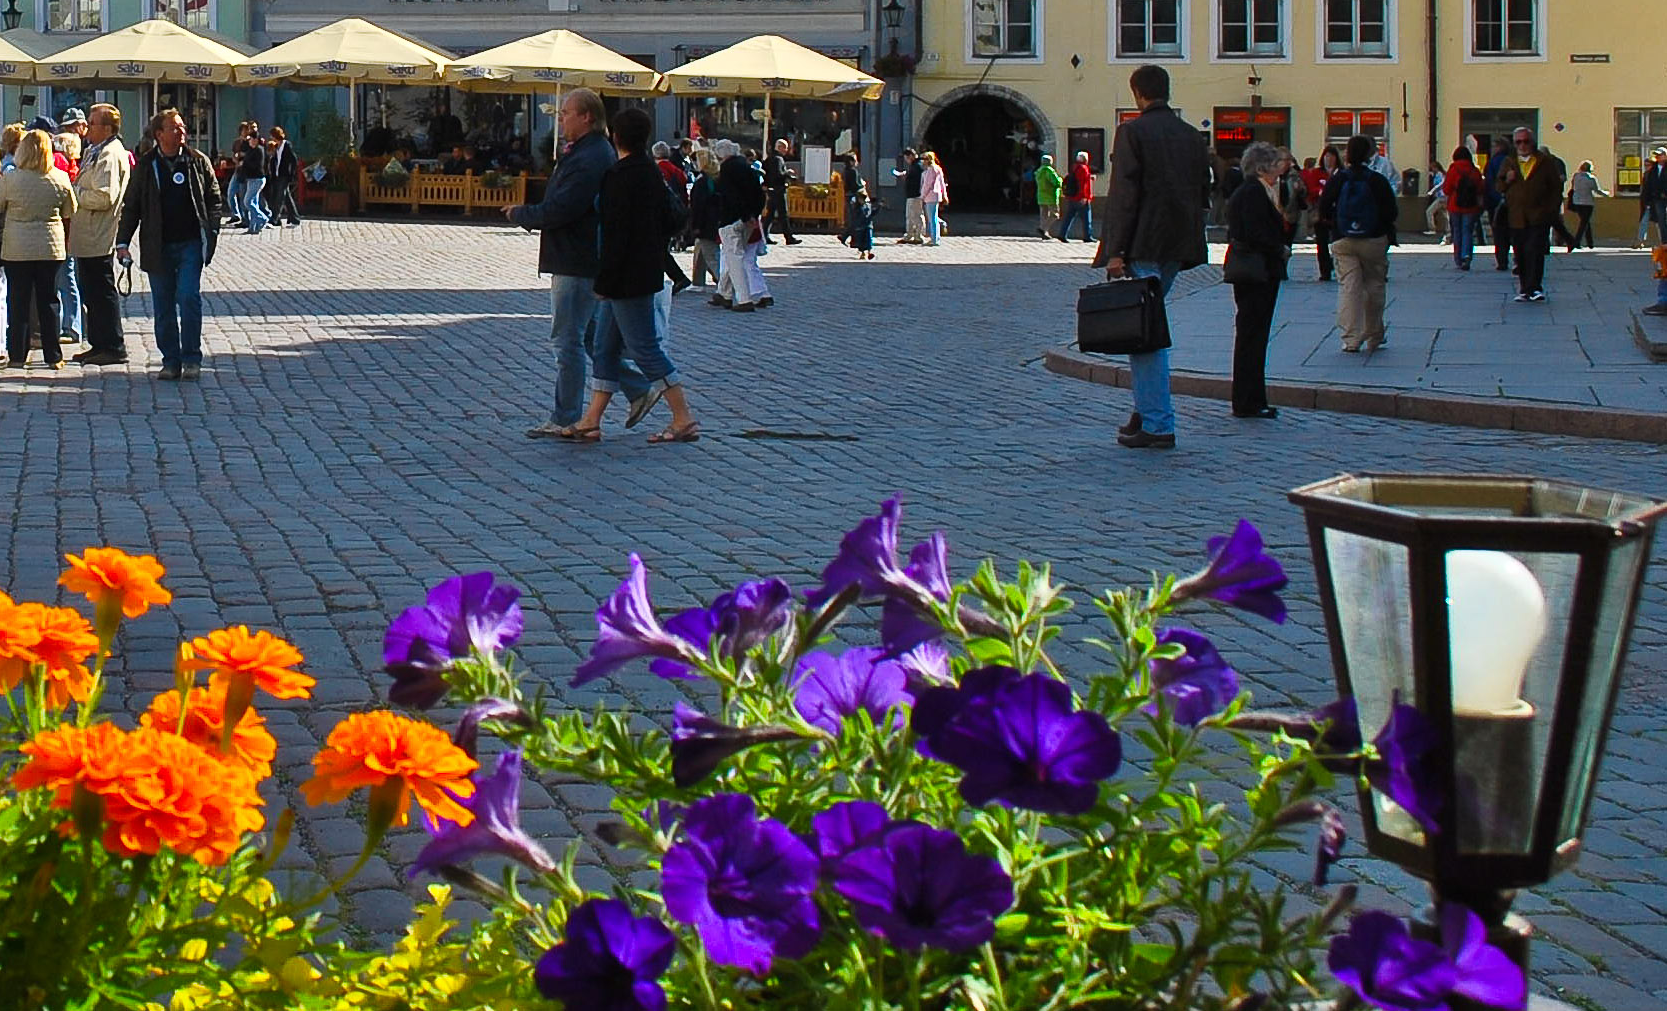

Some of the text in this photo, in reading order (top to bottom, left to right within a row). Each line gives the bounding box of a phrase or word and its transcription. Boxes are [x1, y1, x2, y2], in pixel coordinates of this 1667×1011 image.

[50, 62, 79, 75] saku
[116, 61, 145, 74] saku
[184, 64, 213, 77] saku
[250, 65, 279, 76] saku
[605, 71, 635, 84] saku
[688, 76, 718, 87] saku
